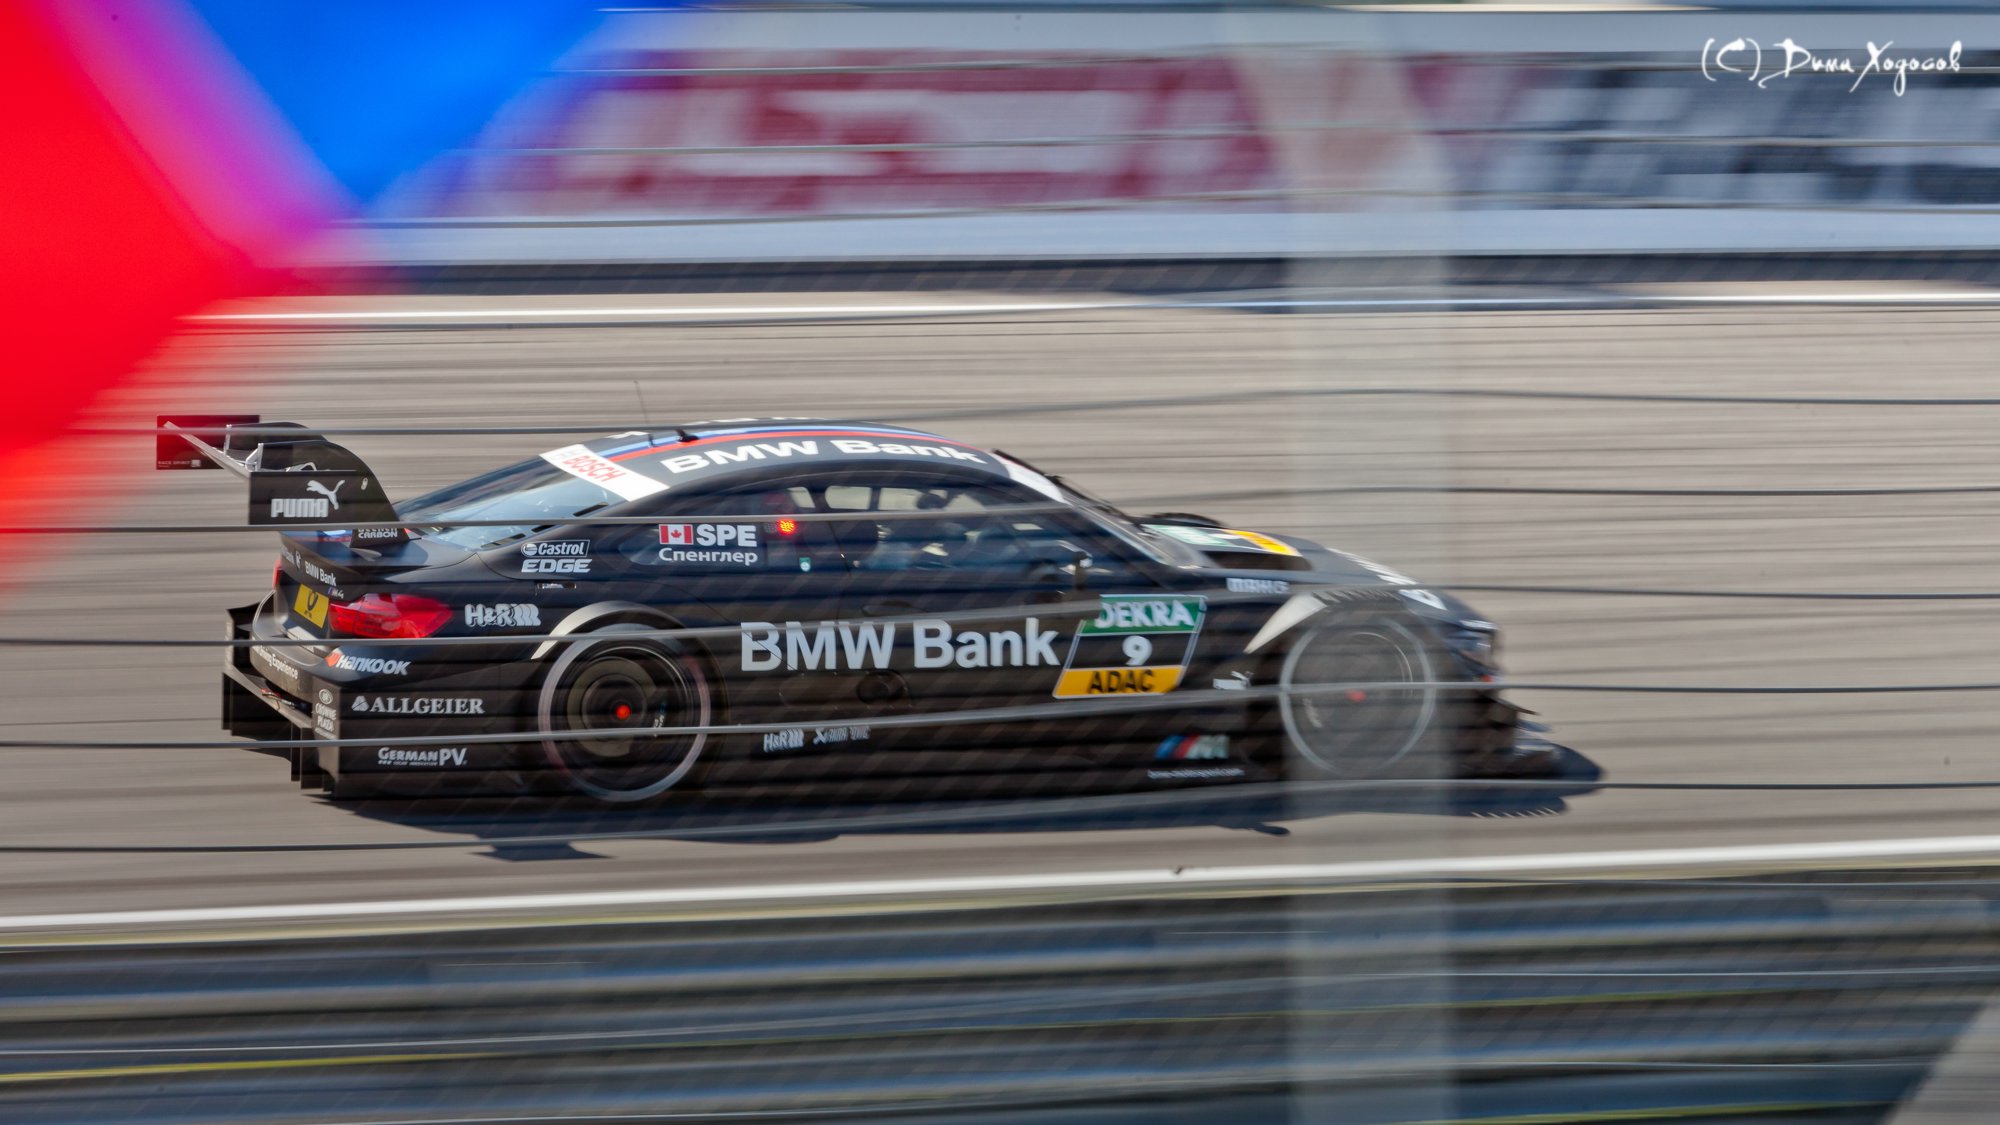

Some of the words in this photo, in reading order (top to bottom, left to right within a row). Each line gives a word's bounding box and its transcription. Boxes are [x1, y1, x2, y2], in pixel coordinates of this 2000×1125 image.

[562, 455, 627, 482] BOSCH
[659, 439, 818, 474] BMW
[830, 439, 988, 464] Bank
[270, 498, 329, 518] PUMA
[358, 530, 398, 539] CARBON
[696, 523, 757, 548] SPE
[538, 541, 584, 555] Castrol
[658, 547, 758, 567] Спенглер
[304, 561, 320, 580] BMW
[320, 568, 337, 587] Bank
[521, 559, 592, 573] EDGE
[1094, 599, 1195, 628] DEKRA
[740, 620, 896, 672] BMW
[913, 617, 1061, 669] Bank
[1121, 634, 1153, 666] 9
[1087, 668, 1154, 694] ADAC
[369, 696, 486, 714] ALLGEIER
